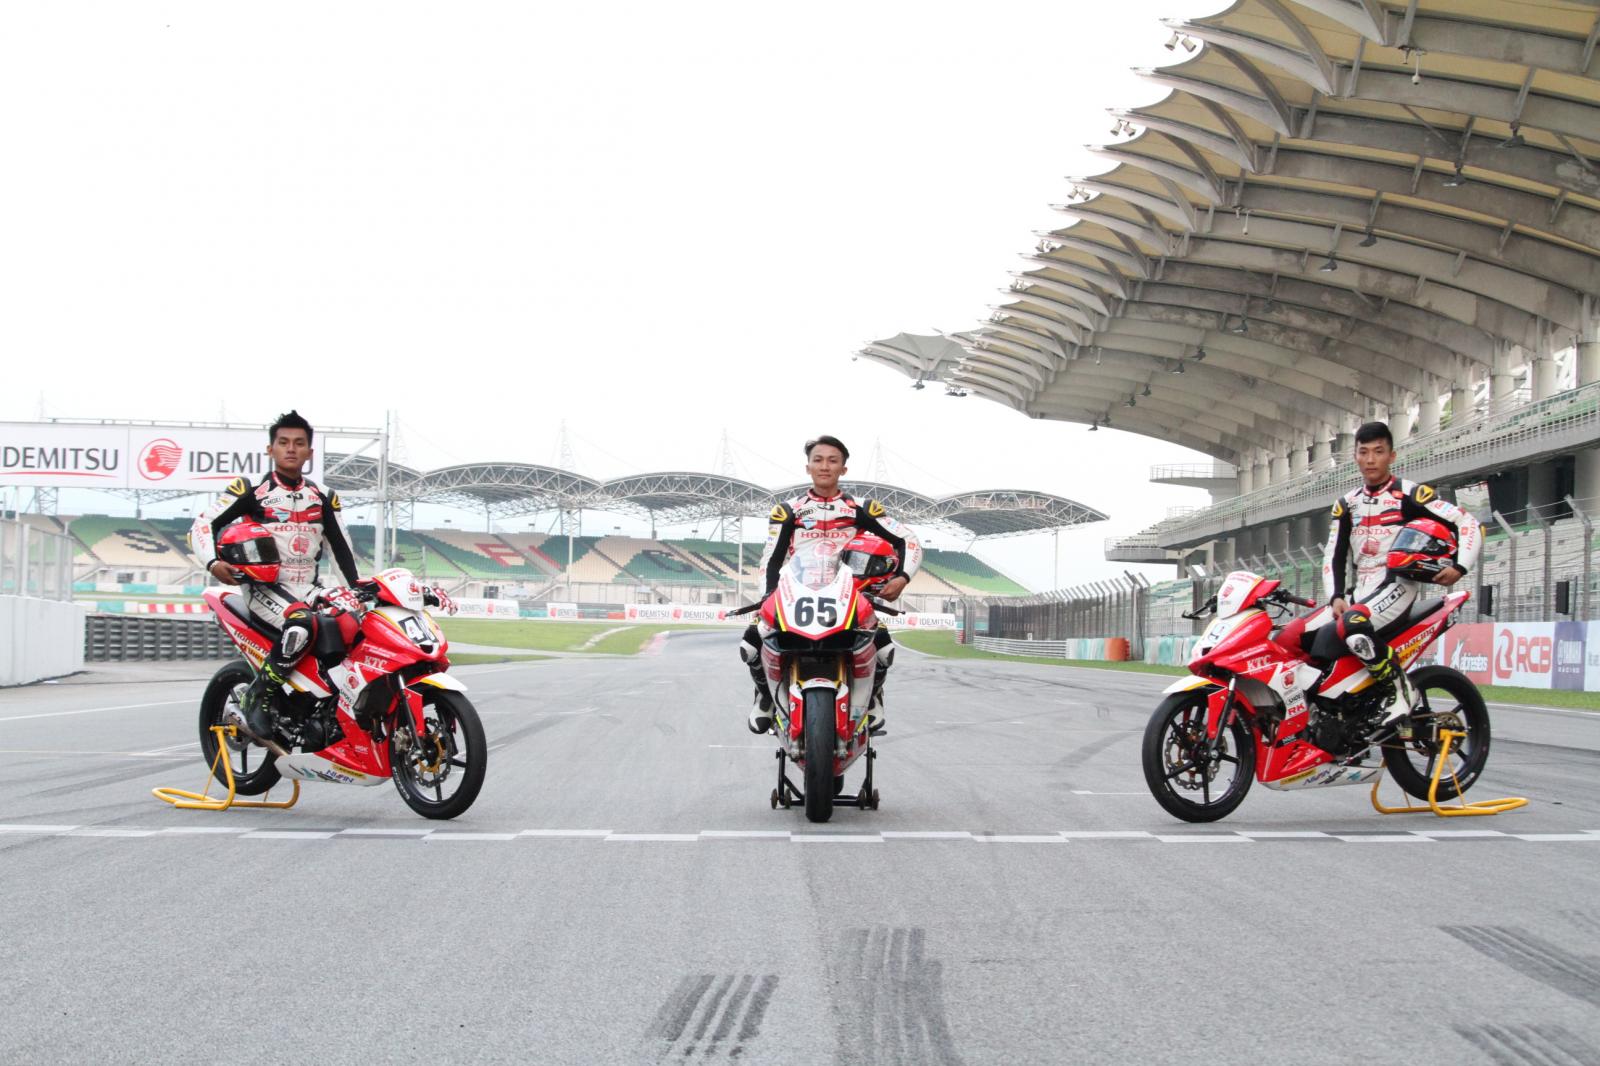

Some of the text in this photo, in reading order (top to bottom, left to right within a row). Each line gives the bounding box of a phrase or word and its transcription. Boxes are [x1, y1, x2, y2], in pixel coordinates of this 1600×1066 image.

[0, 446, 119, 471] DEMITSU
[188, 451, 314, 475] IDEMITU
[274, 525, 318, 535] HONDA
[801, 531, 850, 539] HONDA
[639, 610, 670, 618] IDEMITSU
[684, 612, 715, 620] IDEMITSU
[794, 596, 838, 628] 65
[920, 618, 954, 627] IDEMITSU
[1517, 636, 1552, 673] RCB
[364, 655, 387, 669] KTC
[1247, 655, 1272, 670] KTC
[1288, 703, 1305, 715] RK
